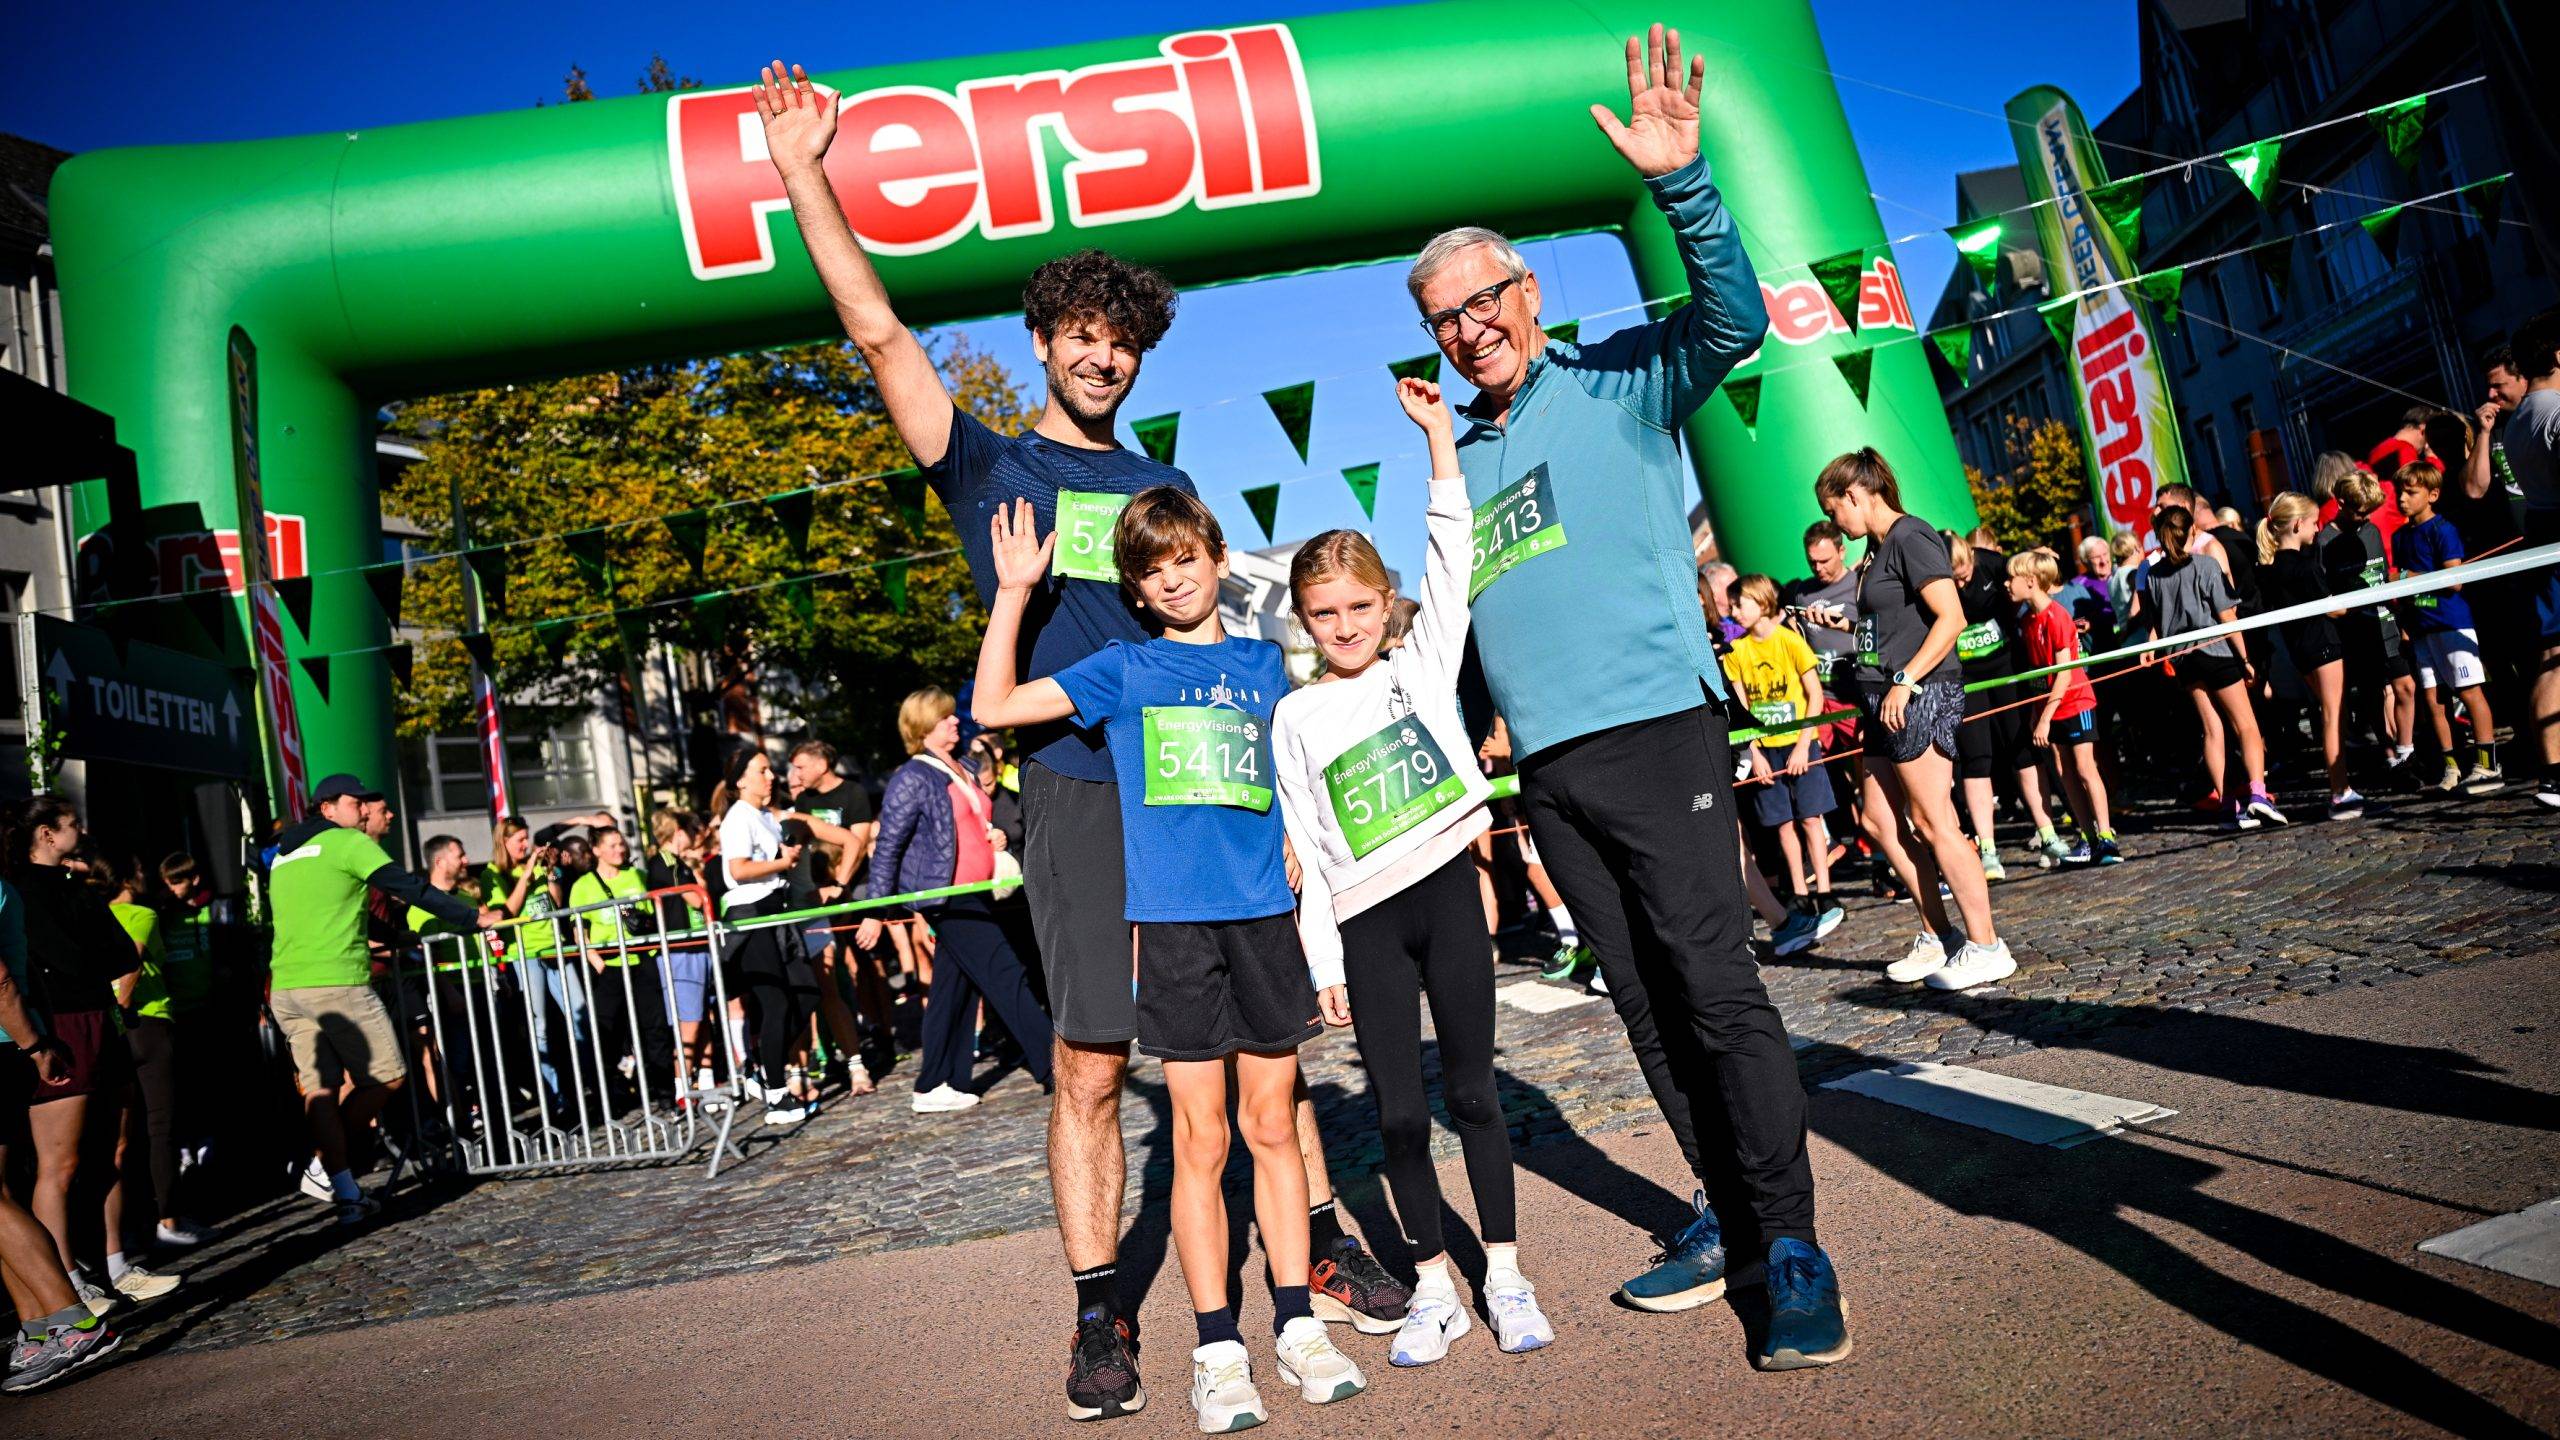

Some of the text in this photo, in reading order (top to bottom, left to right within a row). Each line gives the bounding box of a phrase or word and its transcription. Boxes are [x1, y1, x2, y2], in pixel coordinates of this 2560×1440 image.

[667, 23, 1322, 280] Persil
[1757, 256, 1916, 346] ersil
[1072, 502, 1124, 516] EnergyV
[1071, 520, 1115, 555] 54
[88, 675, 216, 736] TOILETTEN
[1180, 688, 1261, 704] JORDAN
[1157, 719, 1242, 735] EnergyVision
[1159, 741, 1259, 782] 5414
[1333, 739, 1403, 785] EnergyVision
[1240, 789, 1250, 802] 6
[1343, 750, 1438, 825] 5779
